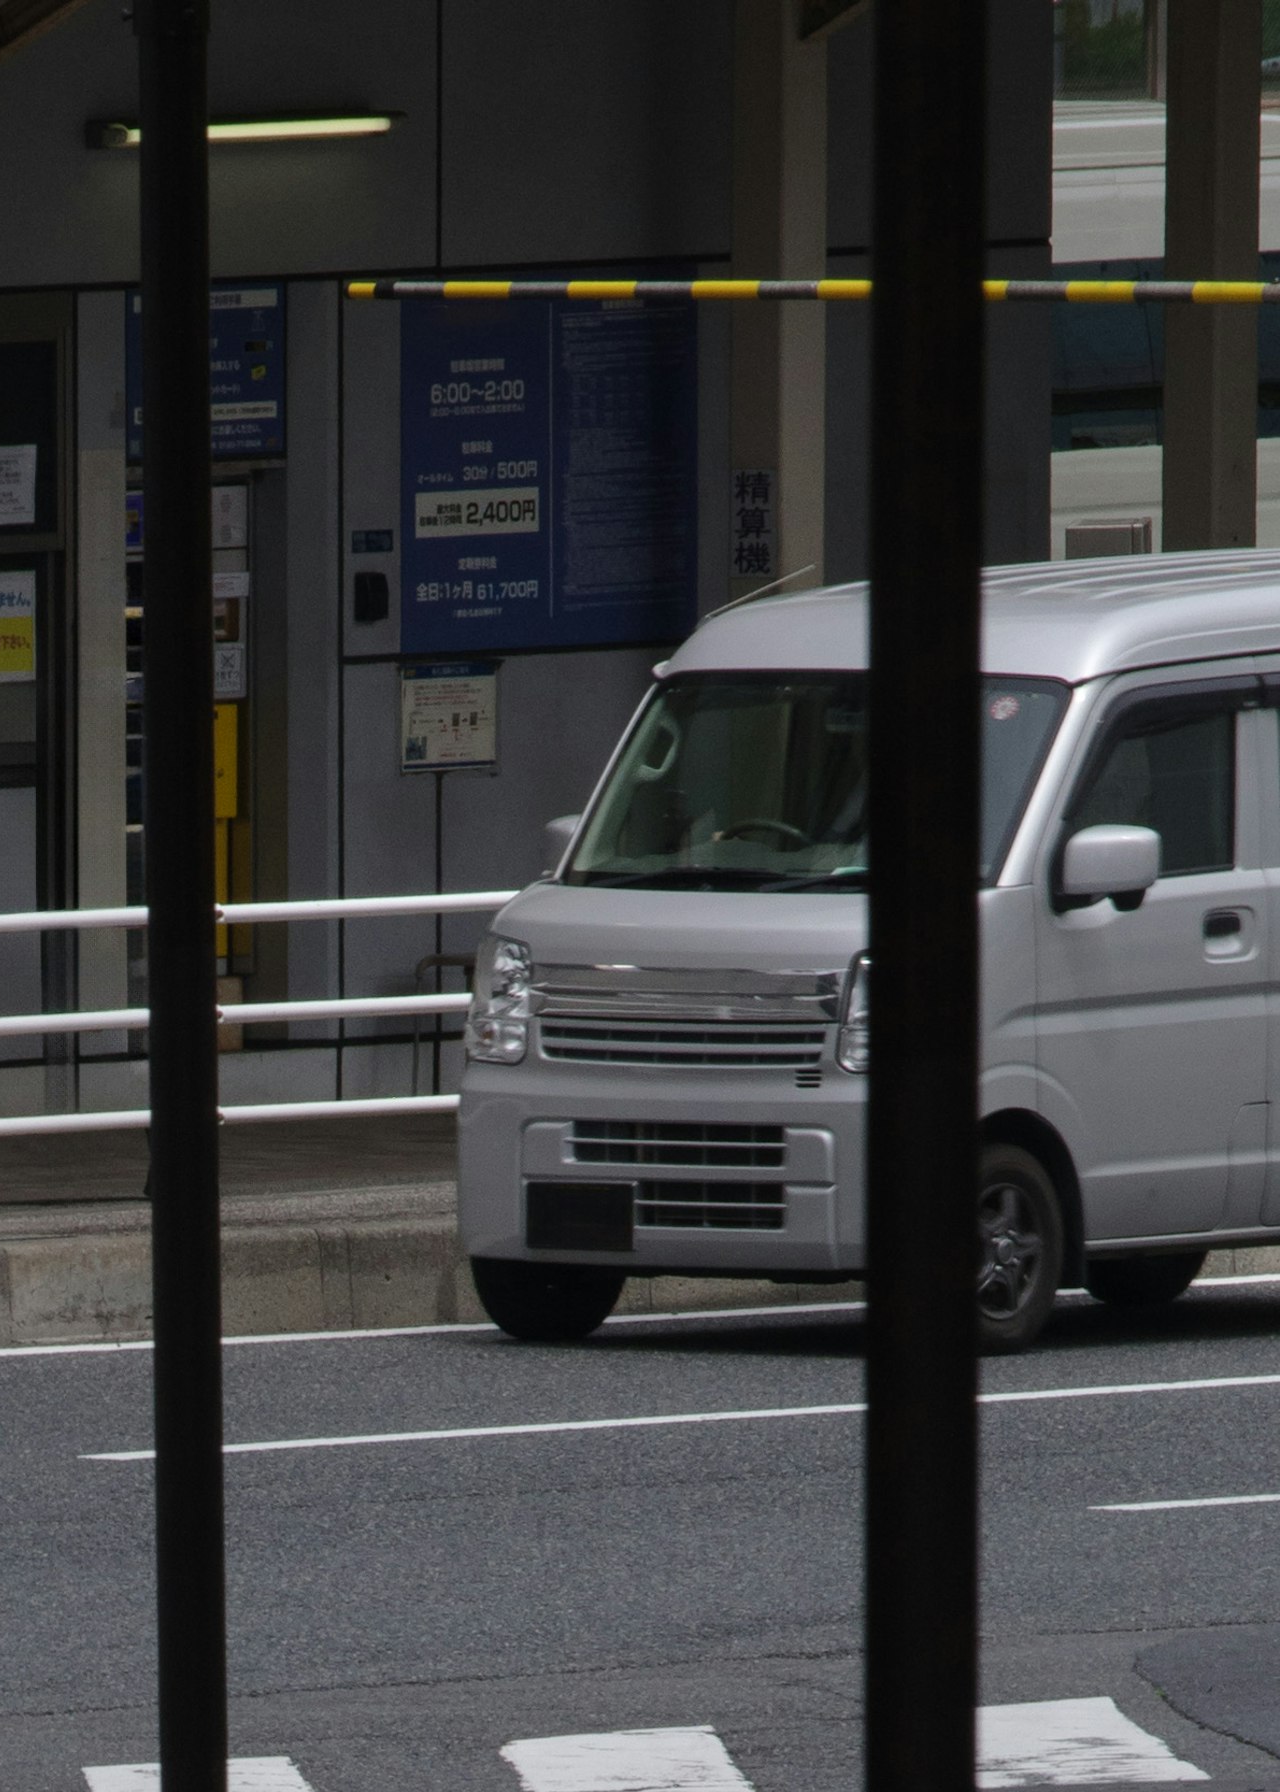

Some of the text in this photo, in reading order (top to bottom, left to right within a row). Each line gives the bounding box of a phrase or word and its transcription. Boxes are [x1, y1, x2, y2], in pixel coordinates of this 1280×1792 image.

[497, 460, 538, 479] 500円
[466, 499, 536, 526] 2,400円
[734, 471, 771, 574] 精算機
[477, 579, 539, 601] 61,700円
